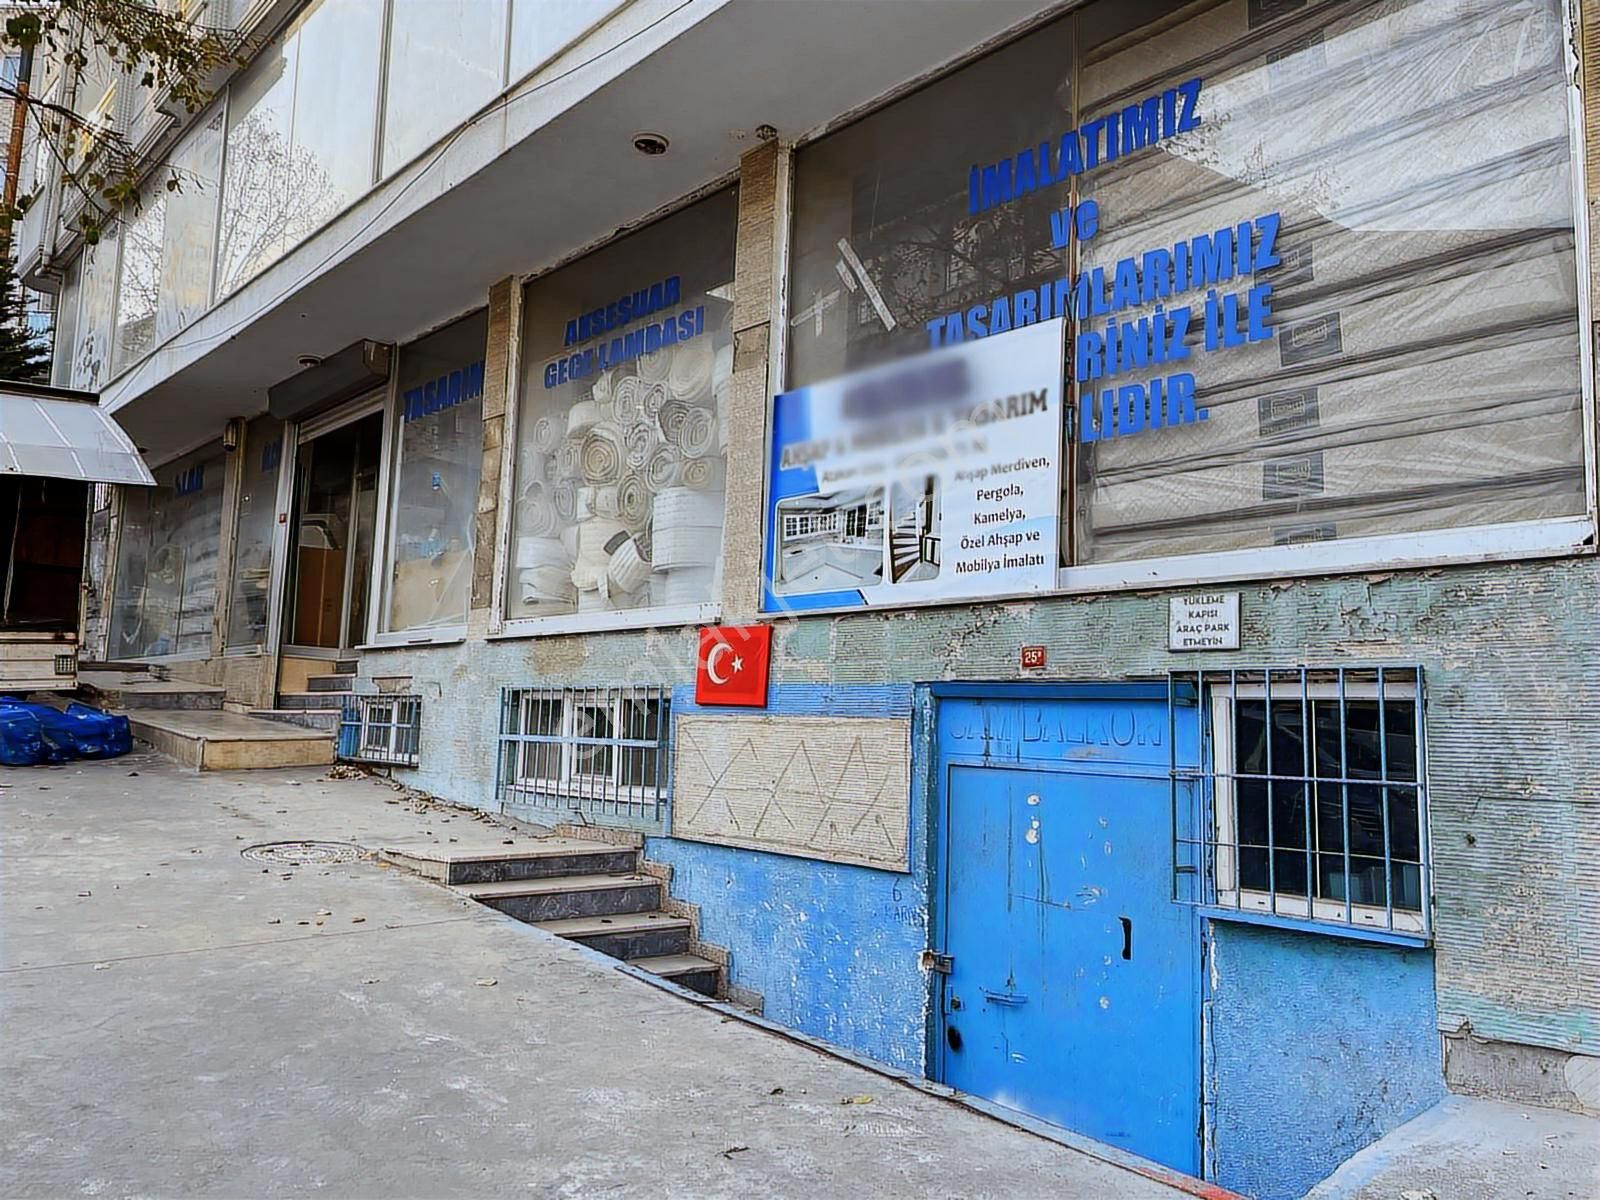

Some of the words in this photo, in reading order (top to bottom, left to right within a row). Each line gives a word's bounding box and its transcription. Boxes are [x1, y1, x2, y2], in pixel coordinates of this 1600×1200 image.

[967, 77, 1203, 216] İMALATIMIZ
[1205, 283, 1274, 352] İLE
[991, 456, 1051, 476] Merdiven,
[976, 483, 1024, 503] Pergola,
[974, 508, 1026, 525] Kamelya,
[960, 534, 985, 550] Özel
[987, 533, 1023, 548] Ahşap
[1025, 530, 1040, 541] ve
[955, 557, 1000, 574] Mobilya
[1003, 553, 1045, 569] İmalatı
[1188, 609, 1218, 619] KAPISI
[1176, 624, 1203, 634] ARAÇ
[1204, 623, 1230, 632] PARK
[1183, 636, 1223, 646] ETMEYİN
